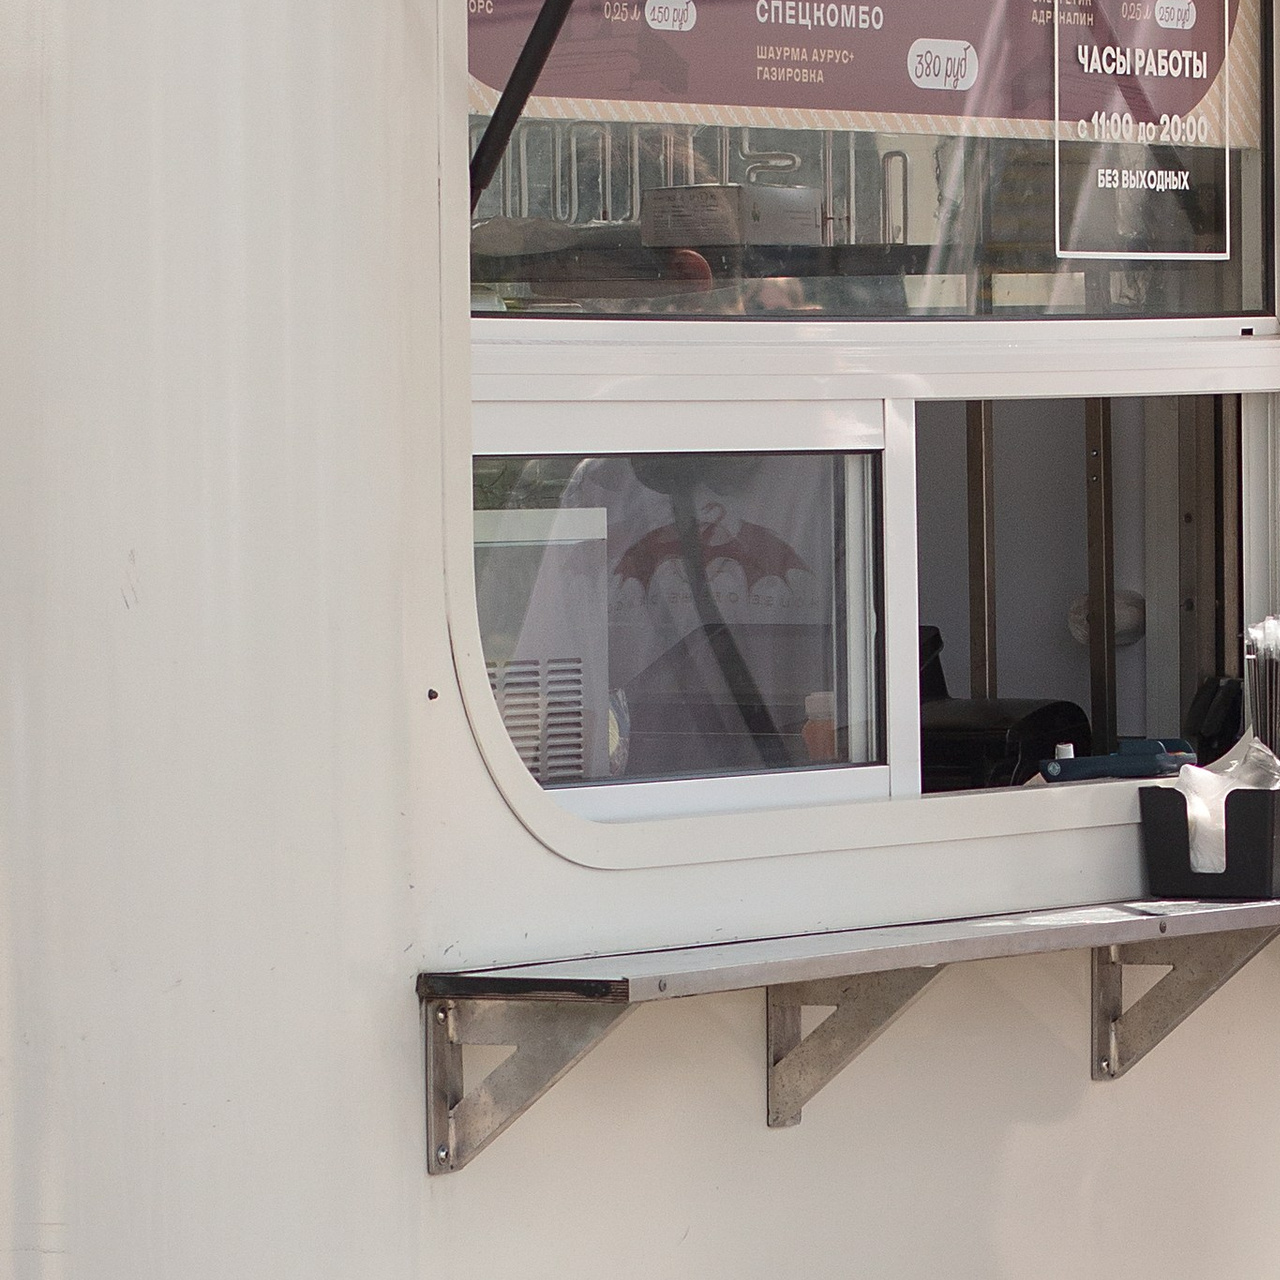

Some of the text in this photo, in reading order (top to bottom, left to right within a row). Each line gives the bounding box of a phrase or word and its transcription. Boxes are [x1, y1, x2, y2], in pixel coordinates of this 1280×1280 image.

[650, 6, 669, 23] 150
[756, 0, 884, 30] СПЕЦКОМБО
[1032, 10, 1094, 26] АДРНАЛИН
[1160, 7, 1175, 22] 250
[756, 45, 808, 62] ШАУРМА
[1077, 45, 1207, 79] ЧАСЫ РАБОТЫ
[757, 66, 824, 83] ГАЗИРОВКА
[915, 50, 941, 79] 380
[1091, 111, 1133, 140] 11:00
[1160, 114, 1208, 143] 20:00
[1097, 169, 1190, 192] БЕЗ ВЫХОДНЫХ
